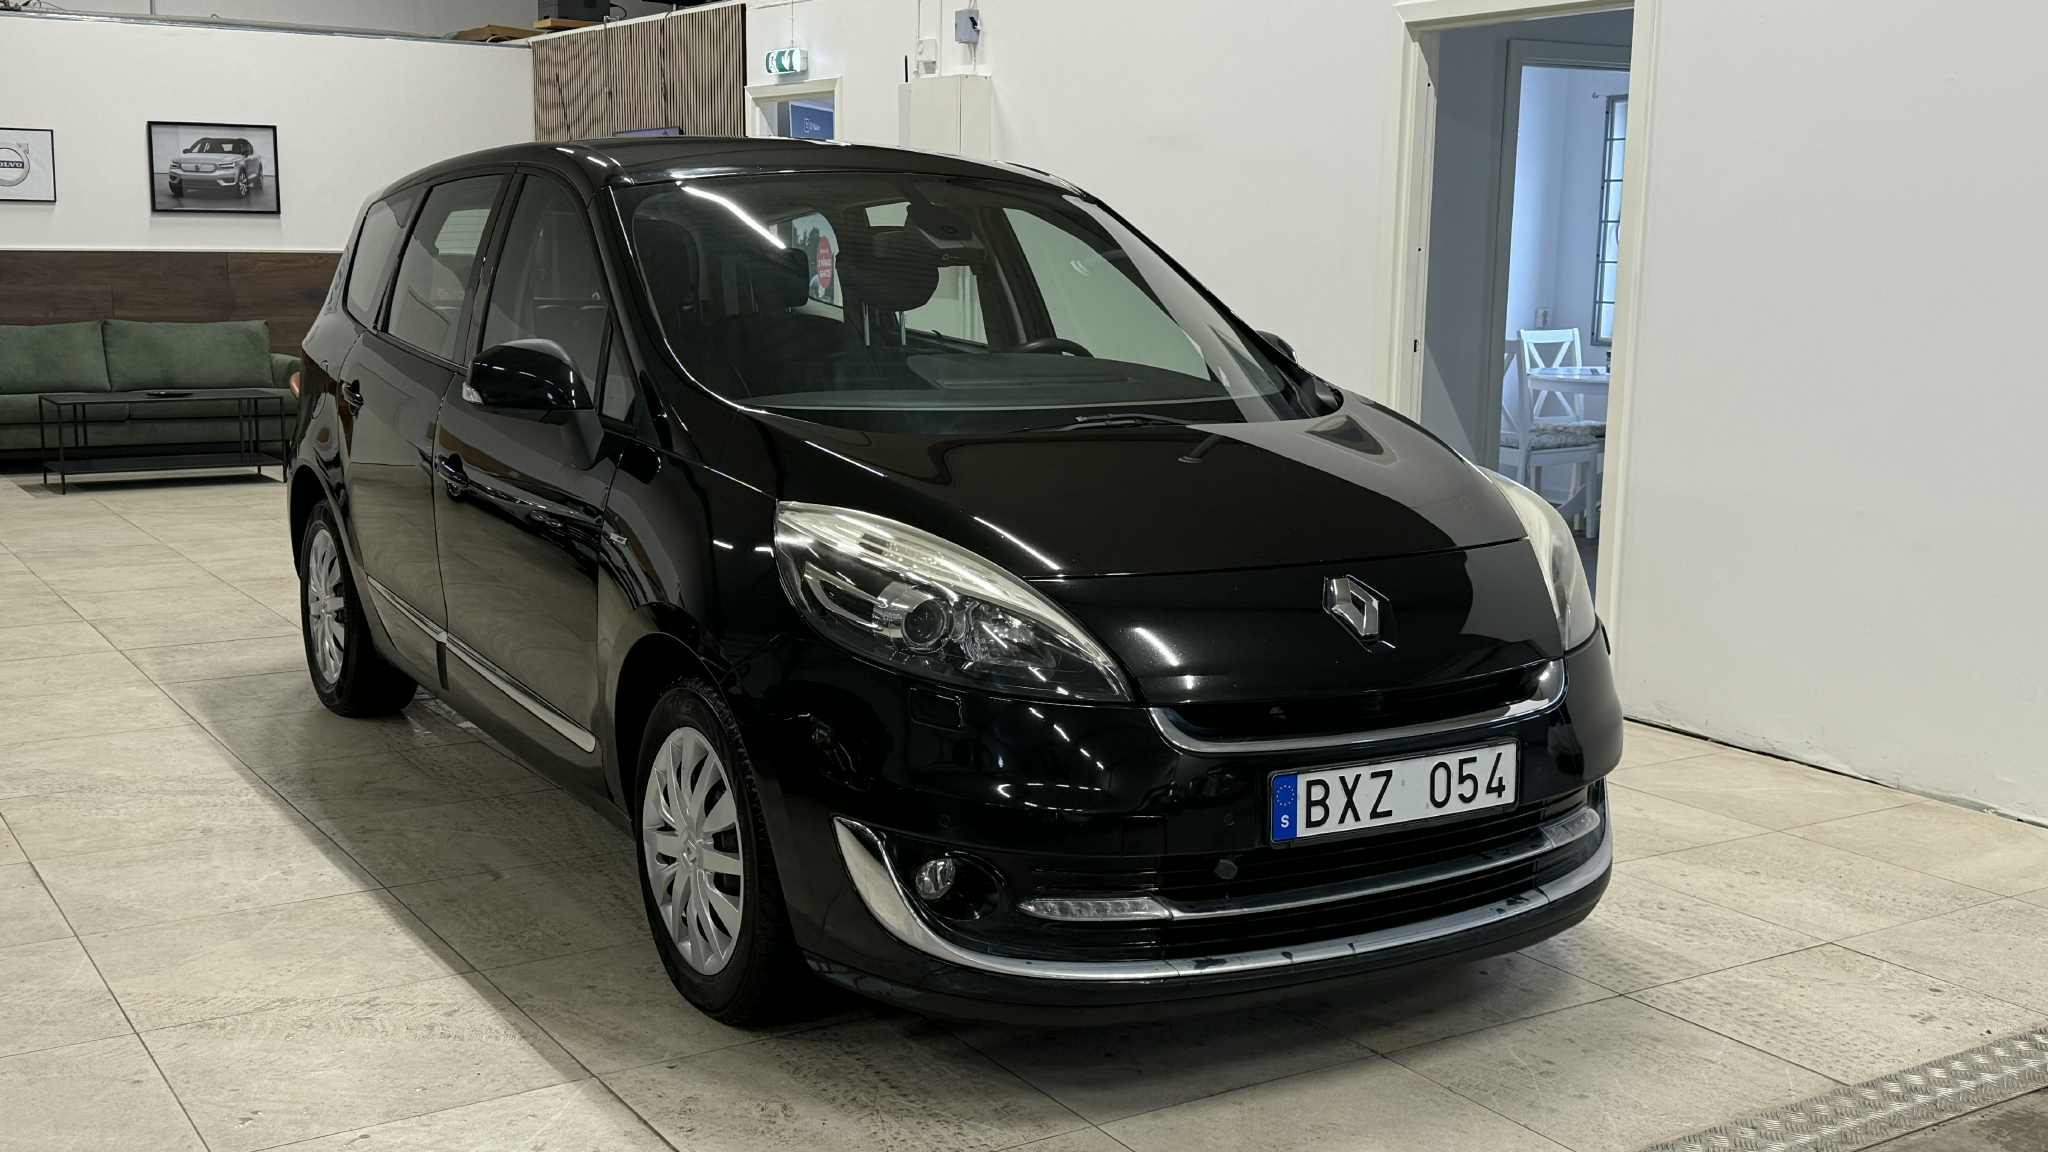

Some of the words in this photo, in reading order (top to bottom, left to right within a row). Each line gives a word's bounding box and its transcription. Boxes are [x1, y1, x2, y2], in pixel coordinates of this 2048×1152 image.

[1305, 769, 1393, 828] BXZ
[1429, 752, 1506, 809] 054
[1280, 814, 1290, 828] S
